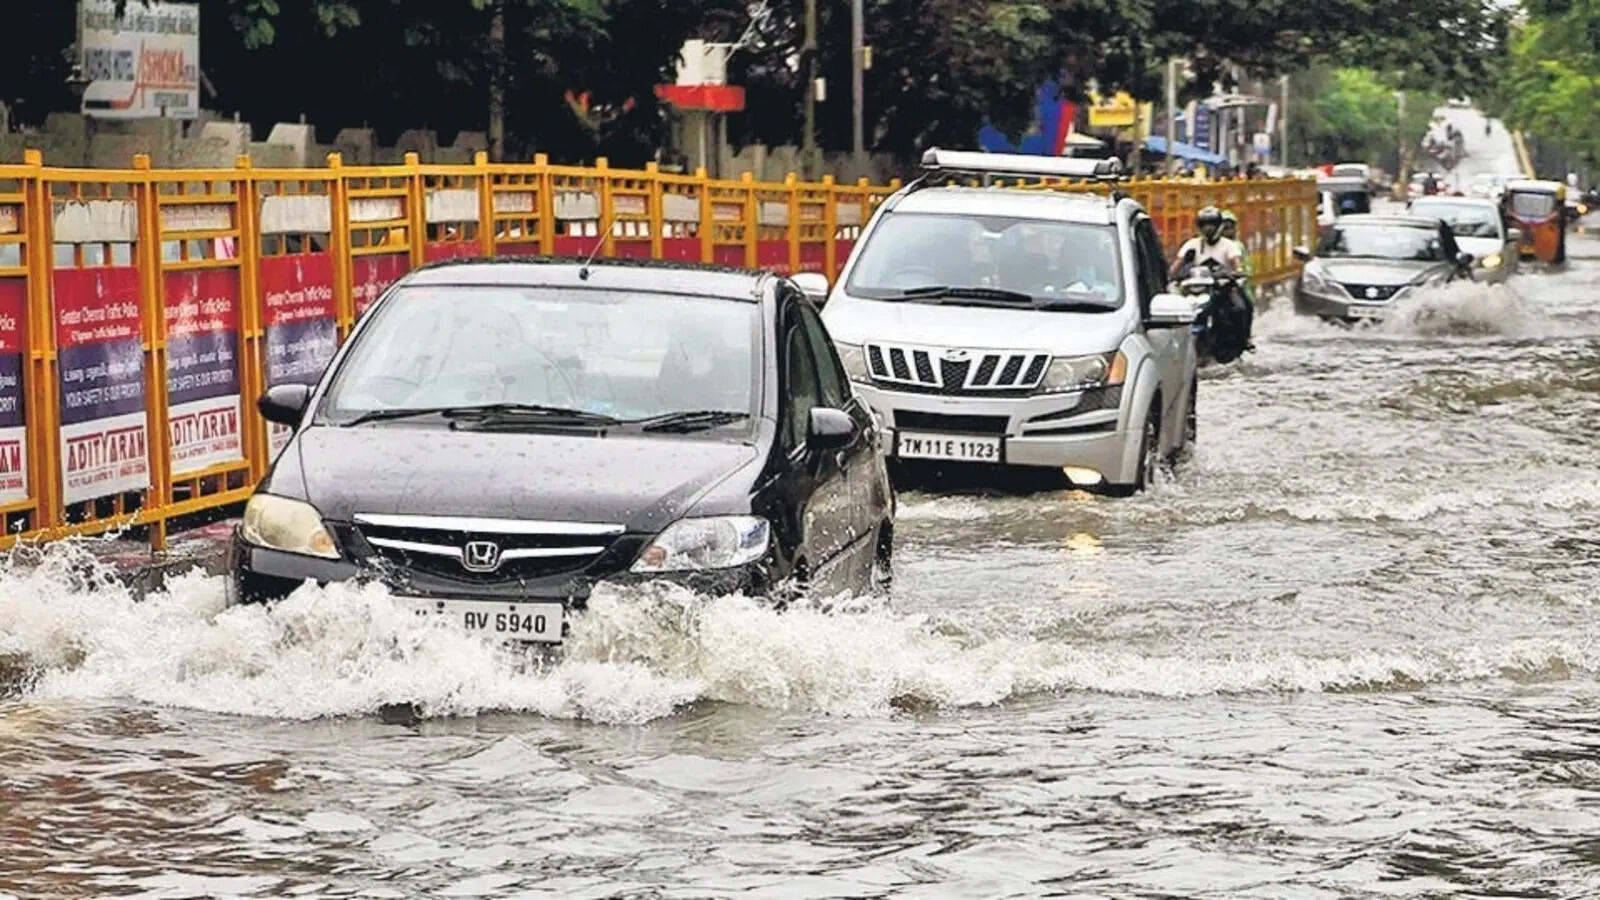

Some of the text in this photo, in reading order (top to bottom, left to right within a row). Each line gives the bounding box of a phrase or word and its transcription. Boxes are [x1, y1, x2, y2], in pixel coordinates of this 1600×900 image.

[67, 425, 145, 472] ADITYARAM
[904, 438, 994, 458] TN 11 E 1123
[464, 611, 489, 630] AV
